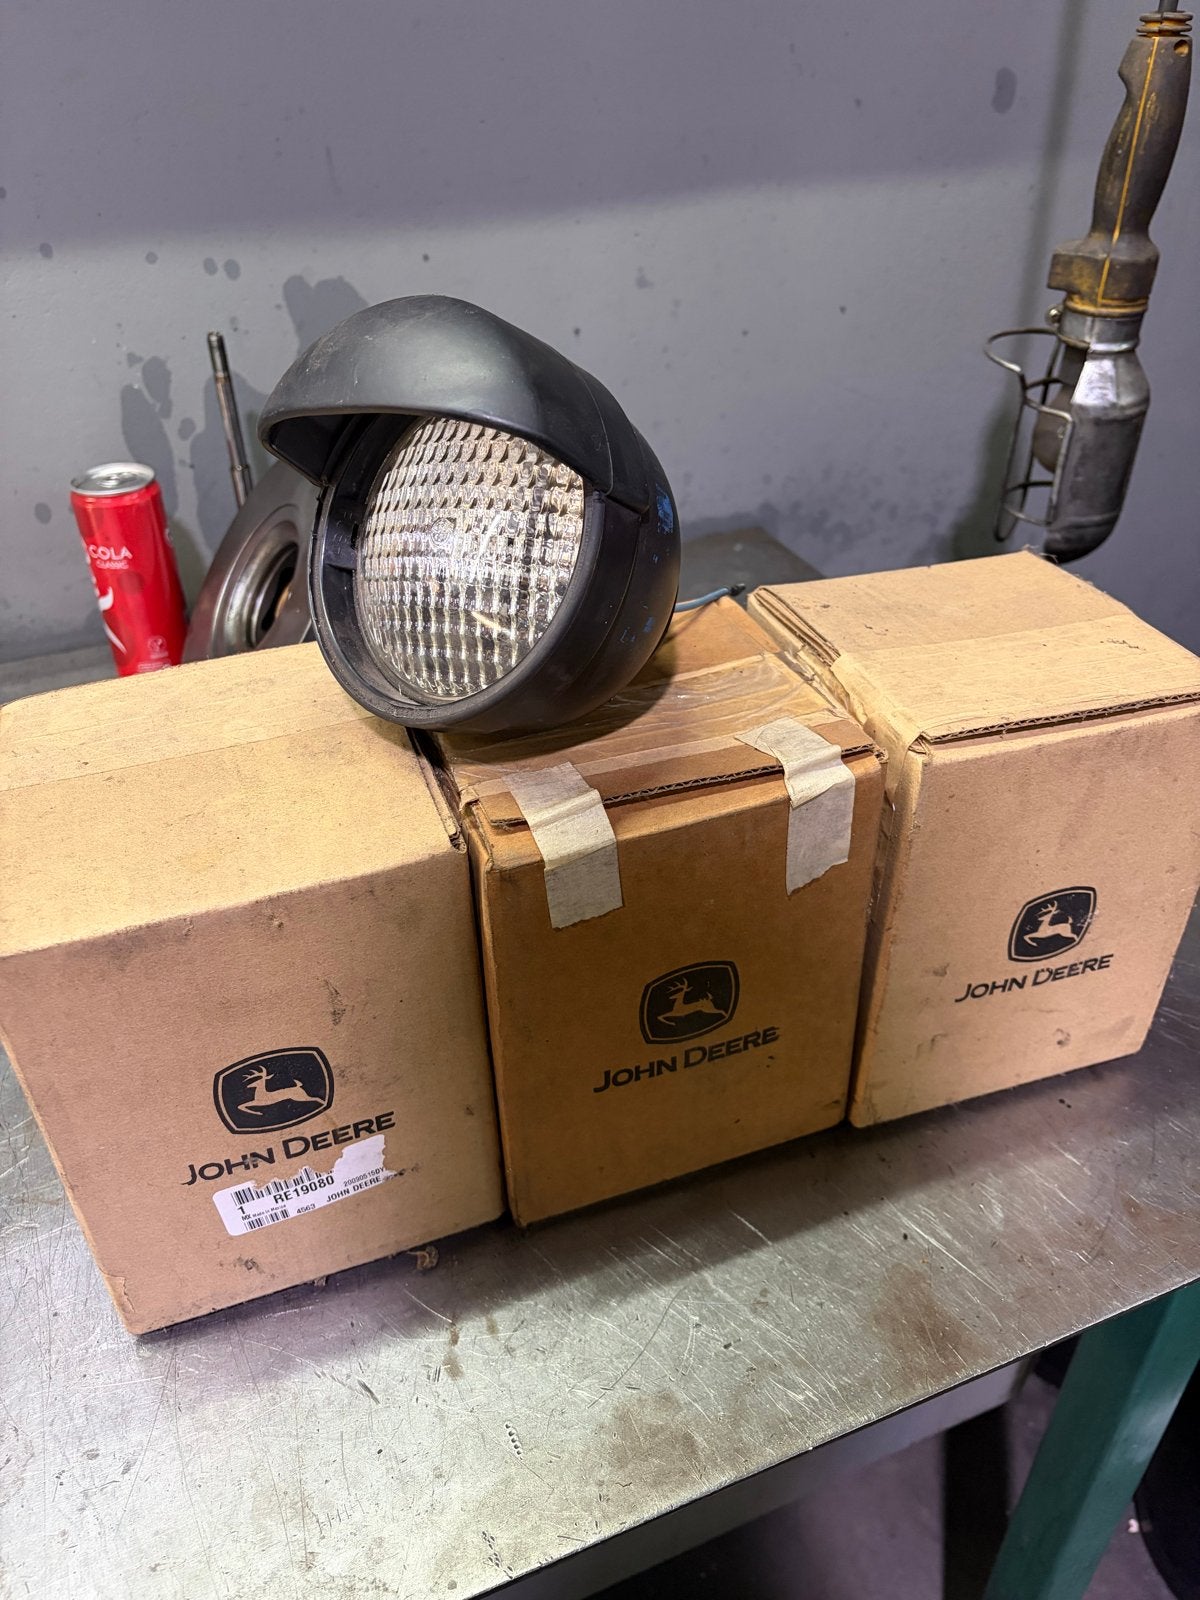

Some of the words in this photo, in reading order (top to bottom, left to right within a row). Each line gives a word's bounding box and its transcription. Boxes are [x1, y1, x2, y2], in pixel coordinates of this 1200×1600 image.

[89, 544, 133, 560] COLA
[954, 975, 1027, 1002] JOHN
[1031, 954, 1114, 986] DEERE
[593, 1056, 677, 1093] JOHN
[683, 1026, 780, 1068] DEERE
[180, 1147, 275, 1186] JOHN
[282, 1111, 396, 1159] DEERE
[273, 1175, 335, 1204] RE19080
[296, 1203, 316, 1214] 4563
[326, 1187, 350, 1202] JOHN
[352, 1175, 381, 1192] DEERE
[237, 1205, 246, 1215] 1
[241, 1213, 252, 1221] MX
